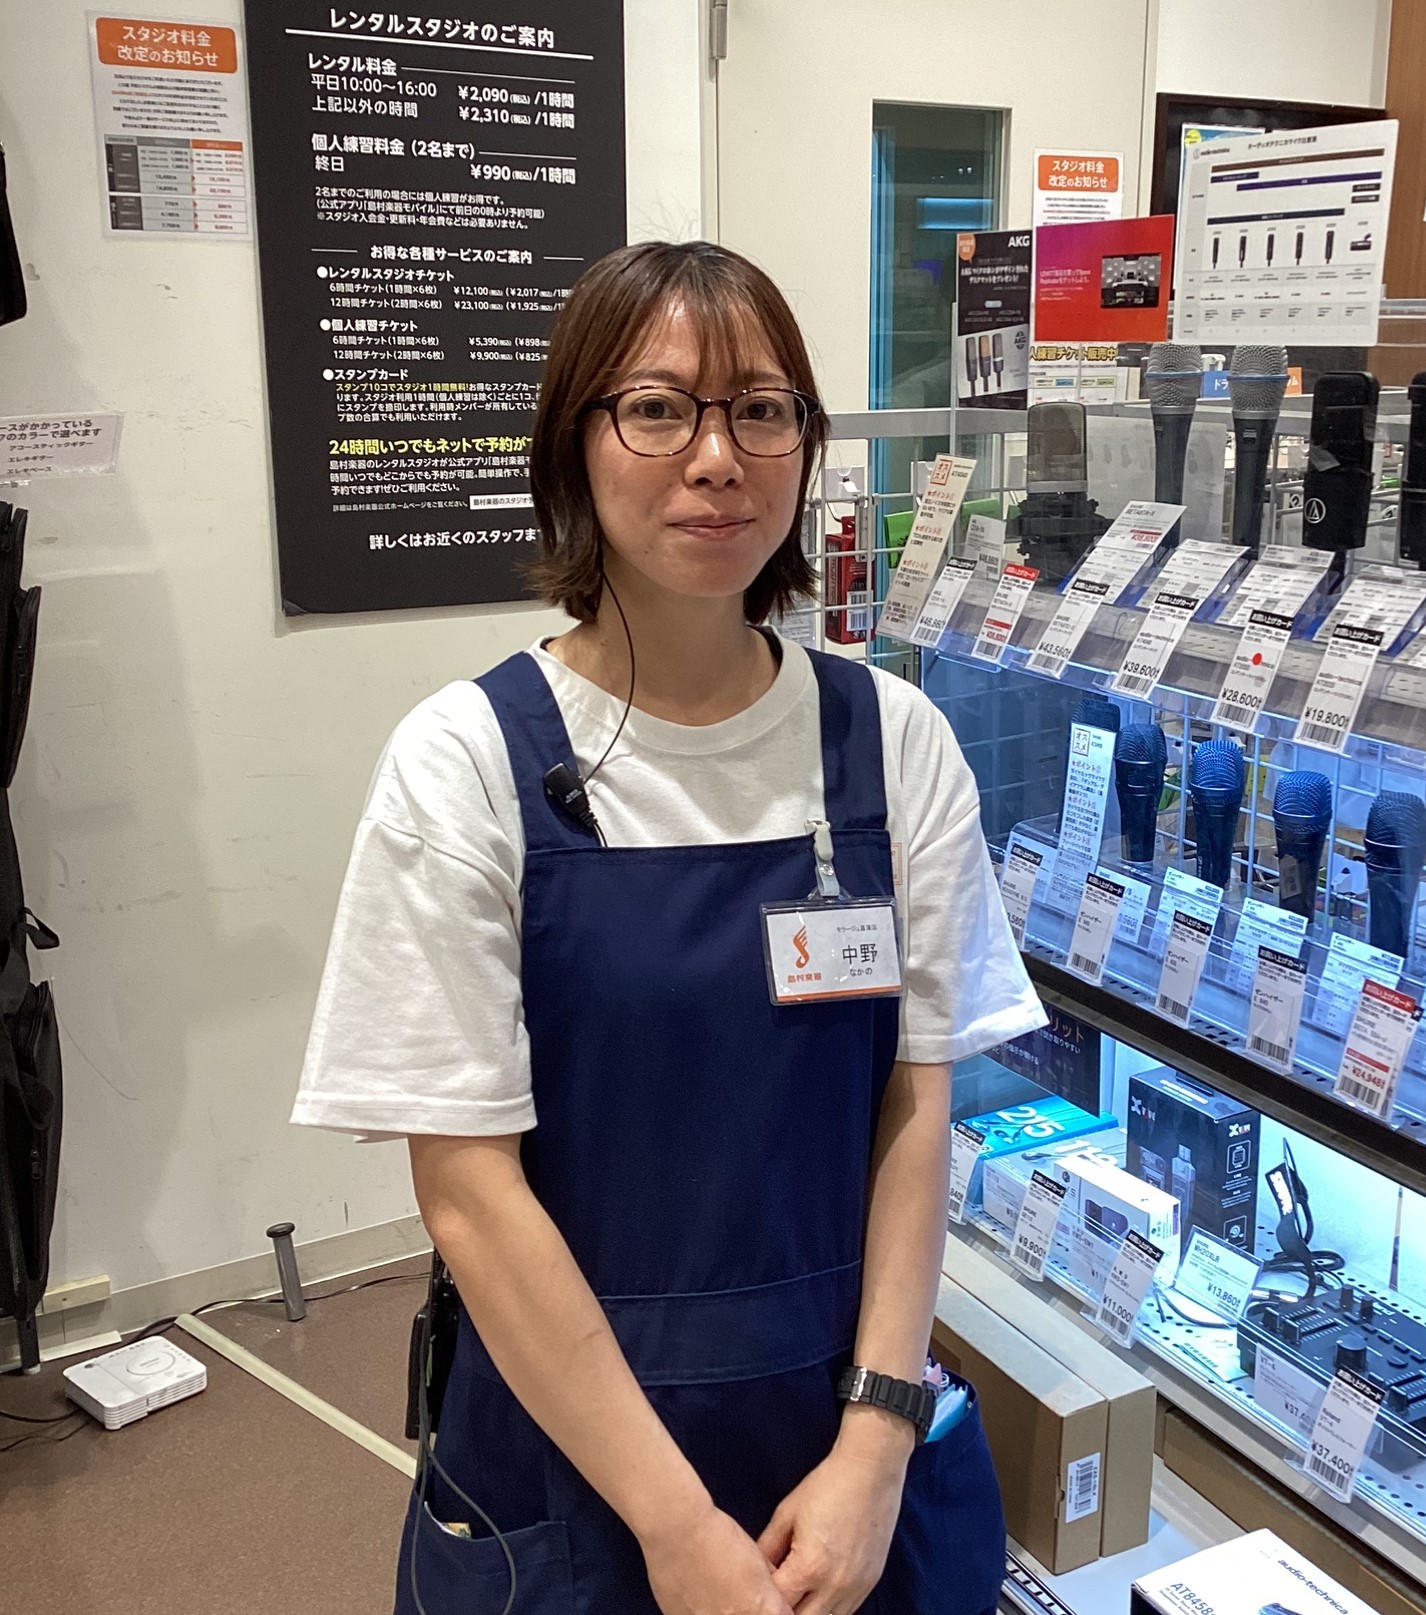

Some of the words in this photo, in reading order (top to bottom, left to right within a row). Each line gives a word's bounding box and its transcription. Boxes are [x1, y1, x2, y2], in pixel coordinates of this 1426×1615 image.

[122, 25, 212, 48] スタジオ料金
[329, 8, 554, 48] レンタルスタジオのご案内
[117, 45, 219, 67] 改定のお知らせ
[307, 52, 397, 76] レンタル料金
[312, 96, 418, 118] 上記以外の時間
[315, 156, 344, 172] 終日
[1052, 159, 1106, 174] スタジオ料金
[1048, 174, 1109, 189] 改定のお知らせ
[1007, 236, 1030, 248] AKG
[370, 245, 533, 264] お得な各種サービスのご案内
[329, 436, 534, 456] 24時間いつでもネットで予約が
[369, 527, 541, 550] 詳しくはお近くのスタッフま
[842, 943, 878, 965] 中野
[849, 967, 873, 977] なかの
[1278, 1558, 1349, 1615] audio-technica
[1170, 1583, 1215, 1615] AT8458
